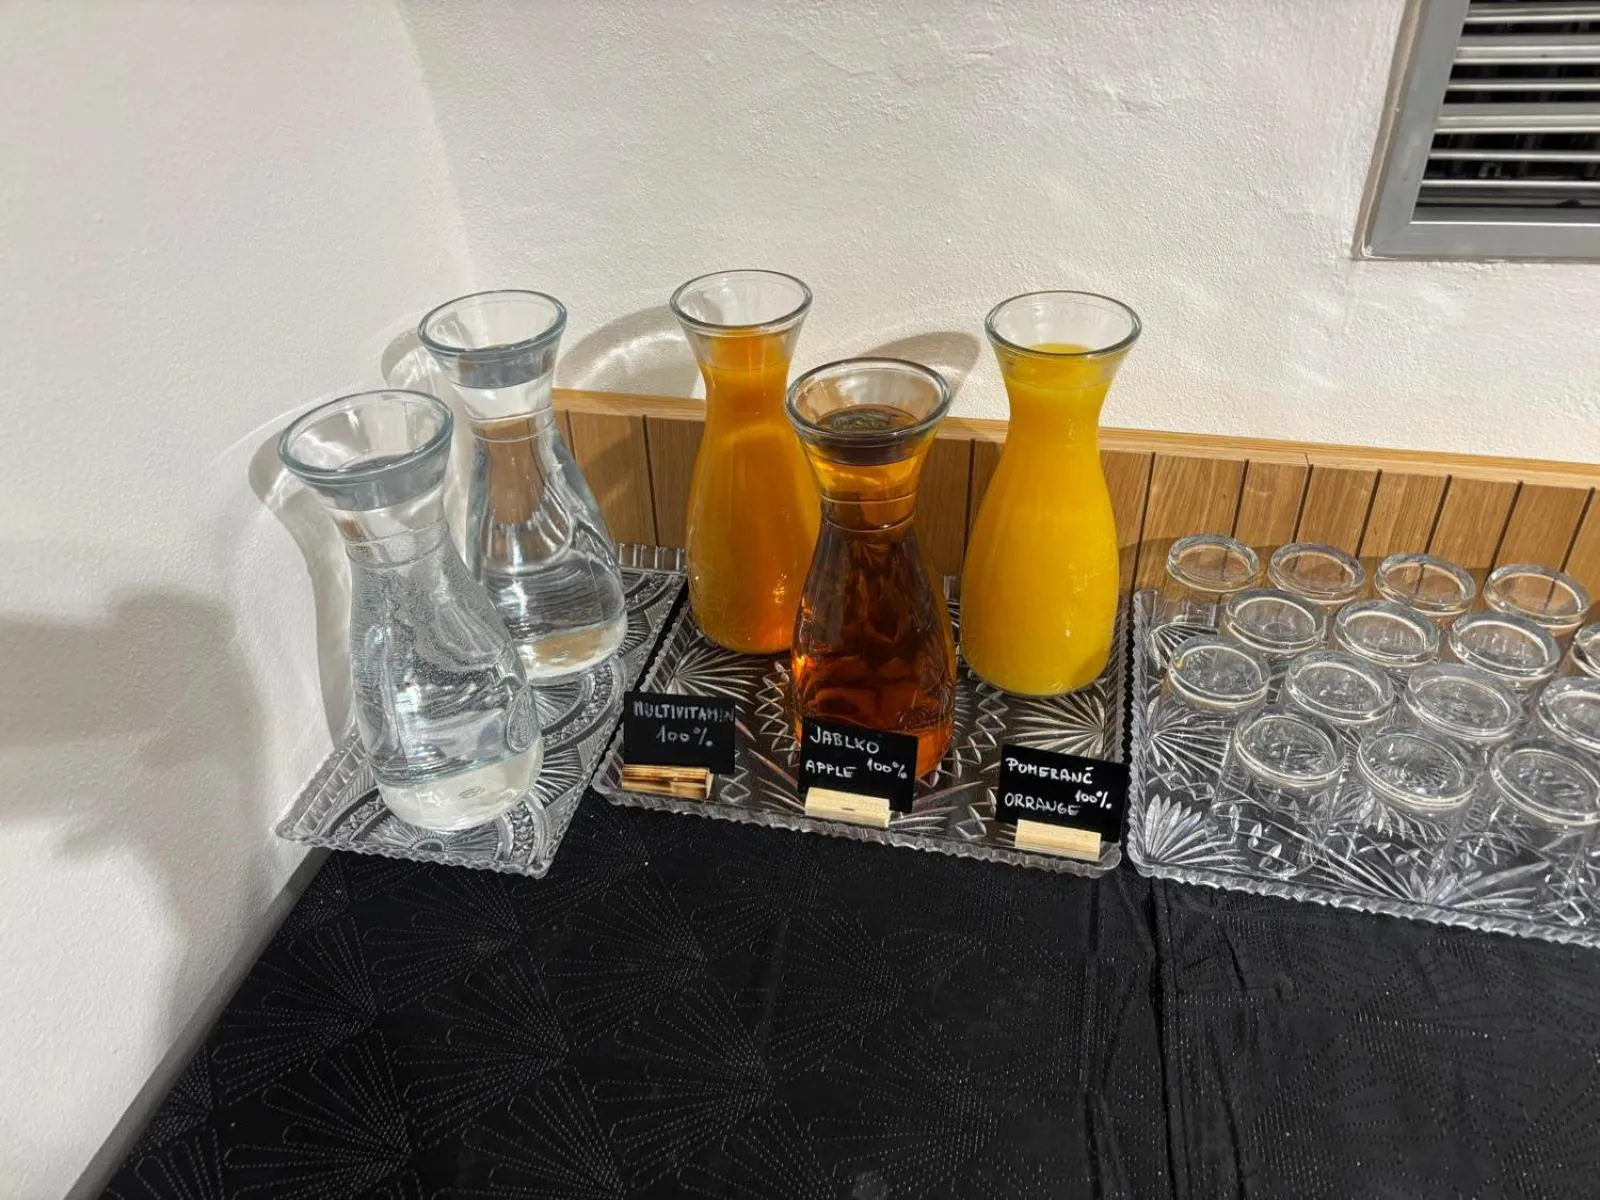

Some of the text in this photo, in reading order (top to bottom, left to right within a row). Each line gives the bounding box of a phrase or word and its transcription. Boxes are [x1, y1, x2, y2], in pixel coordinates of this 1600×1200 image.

[633, 701, 735, 722] MULTIVITAMIN
[656, 725, 713, 747] 100%
[810, 726, 880, 754] JABLKO
[805, 758, 908, 779] APPLE 100%
[1004, 790, 1112, 816] ORRANGE 100%
